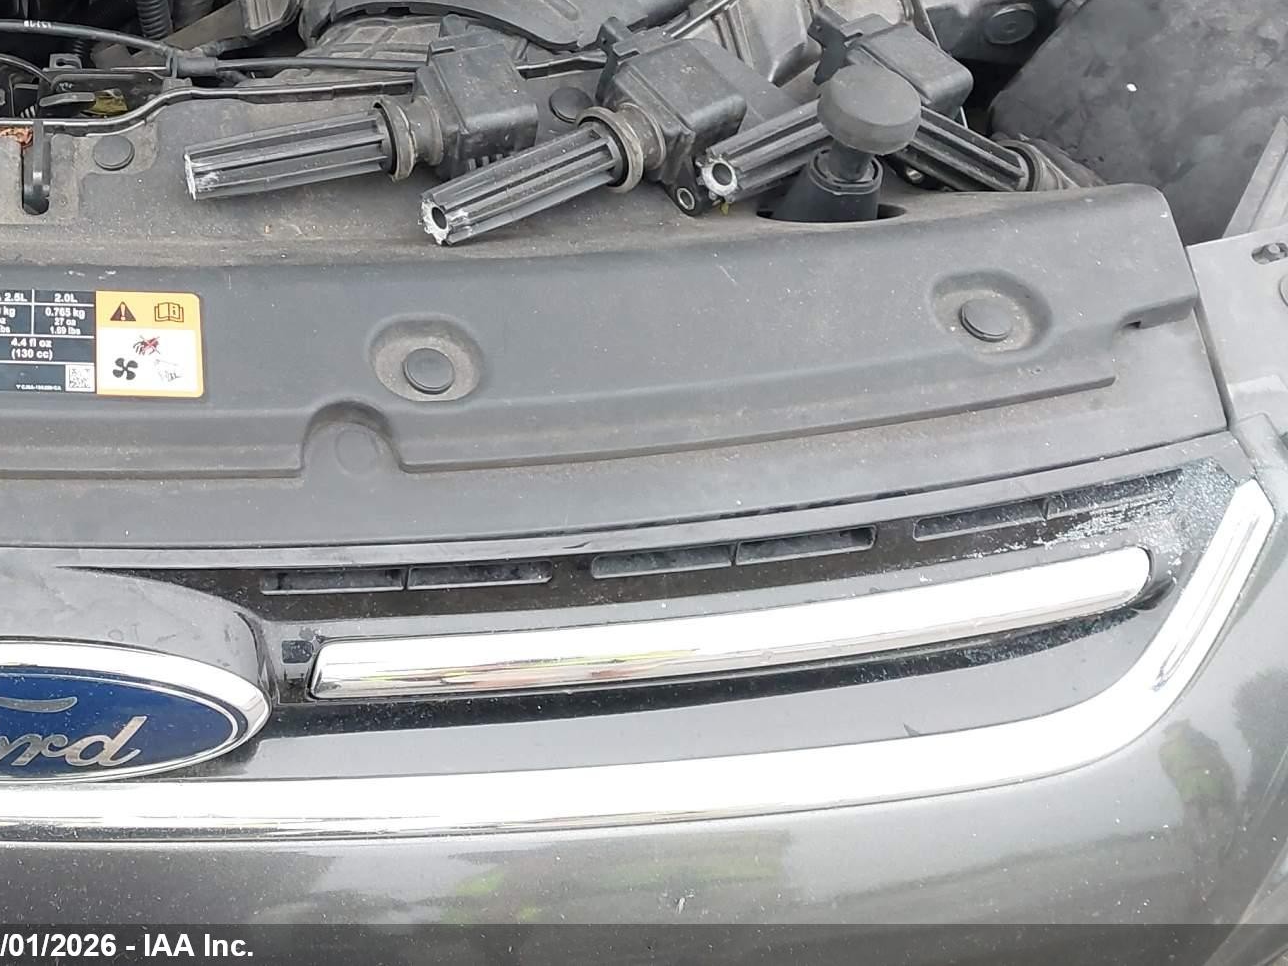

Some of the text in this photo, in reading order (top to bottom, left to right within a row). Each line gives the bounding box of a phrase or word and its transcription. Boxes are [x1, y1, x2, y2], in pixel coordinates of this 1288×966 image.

[4, 292, 28, 302] 2.5L
[54, 293, 78, 303] 2.0L
[3, 306, 16, 318] kg
[72, 307, 86, 320] kg
[54, 318, 64, 326] 27
[67, 326, 81, 335] lbs
[10, 338, 27, 347] 4.4
[38, 339, 52, 348] oz
[11, 348, 53, 361] (130 cc)
